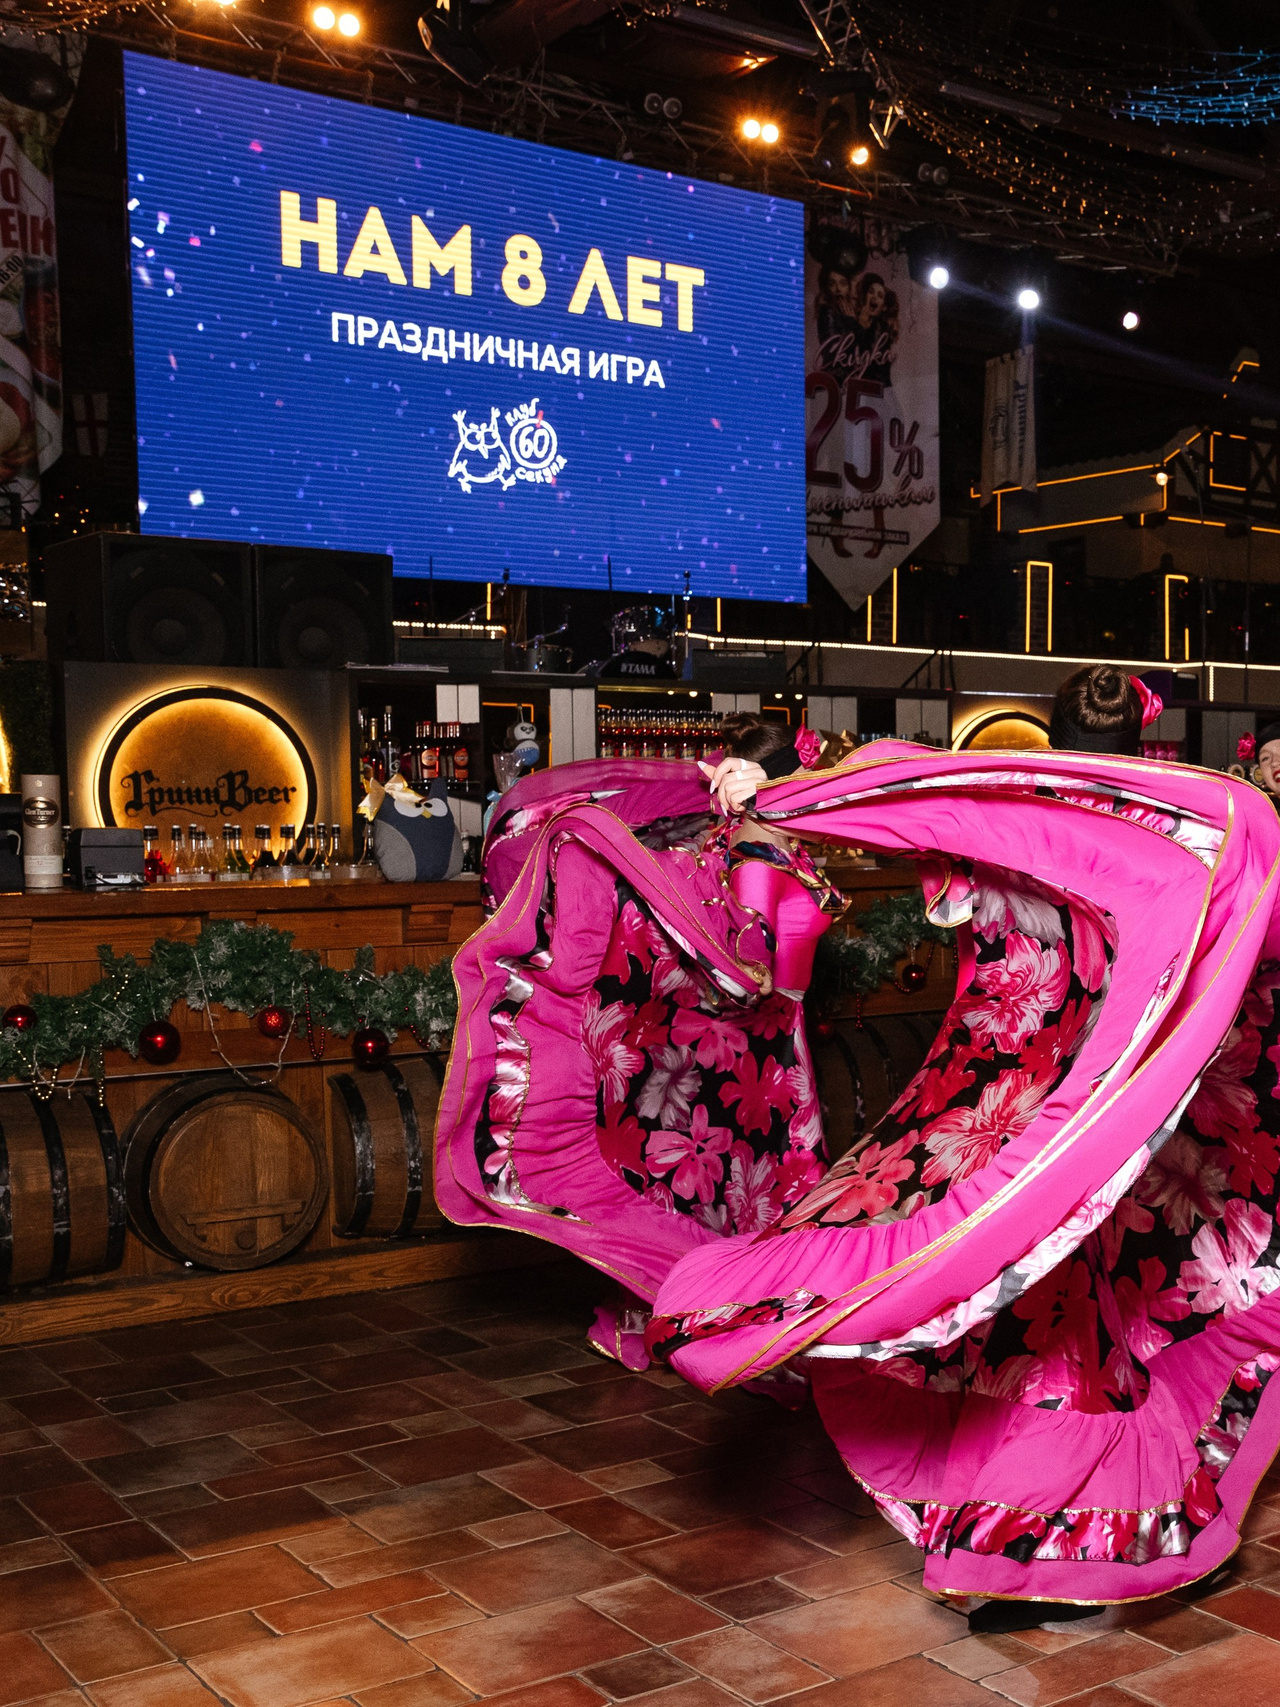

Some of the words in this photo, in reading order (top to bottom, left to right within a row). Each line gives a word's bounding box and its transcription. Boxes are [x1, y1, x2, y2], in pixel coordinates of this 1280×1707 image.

[279, 190, 473, 296] НАМ
[501, 233, 547, 307] 8
[567, 247, 706, 333] ЛЕТ
[331, 311, 580, 378] ПРАЗДНИЧНАЯ
[588, 350, 666, 389] ИГРА
[518, 426, 550, 459] 60
